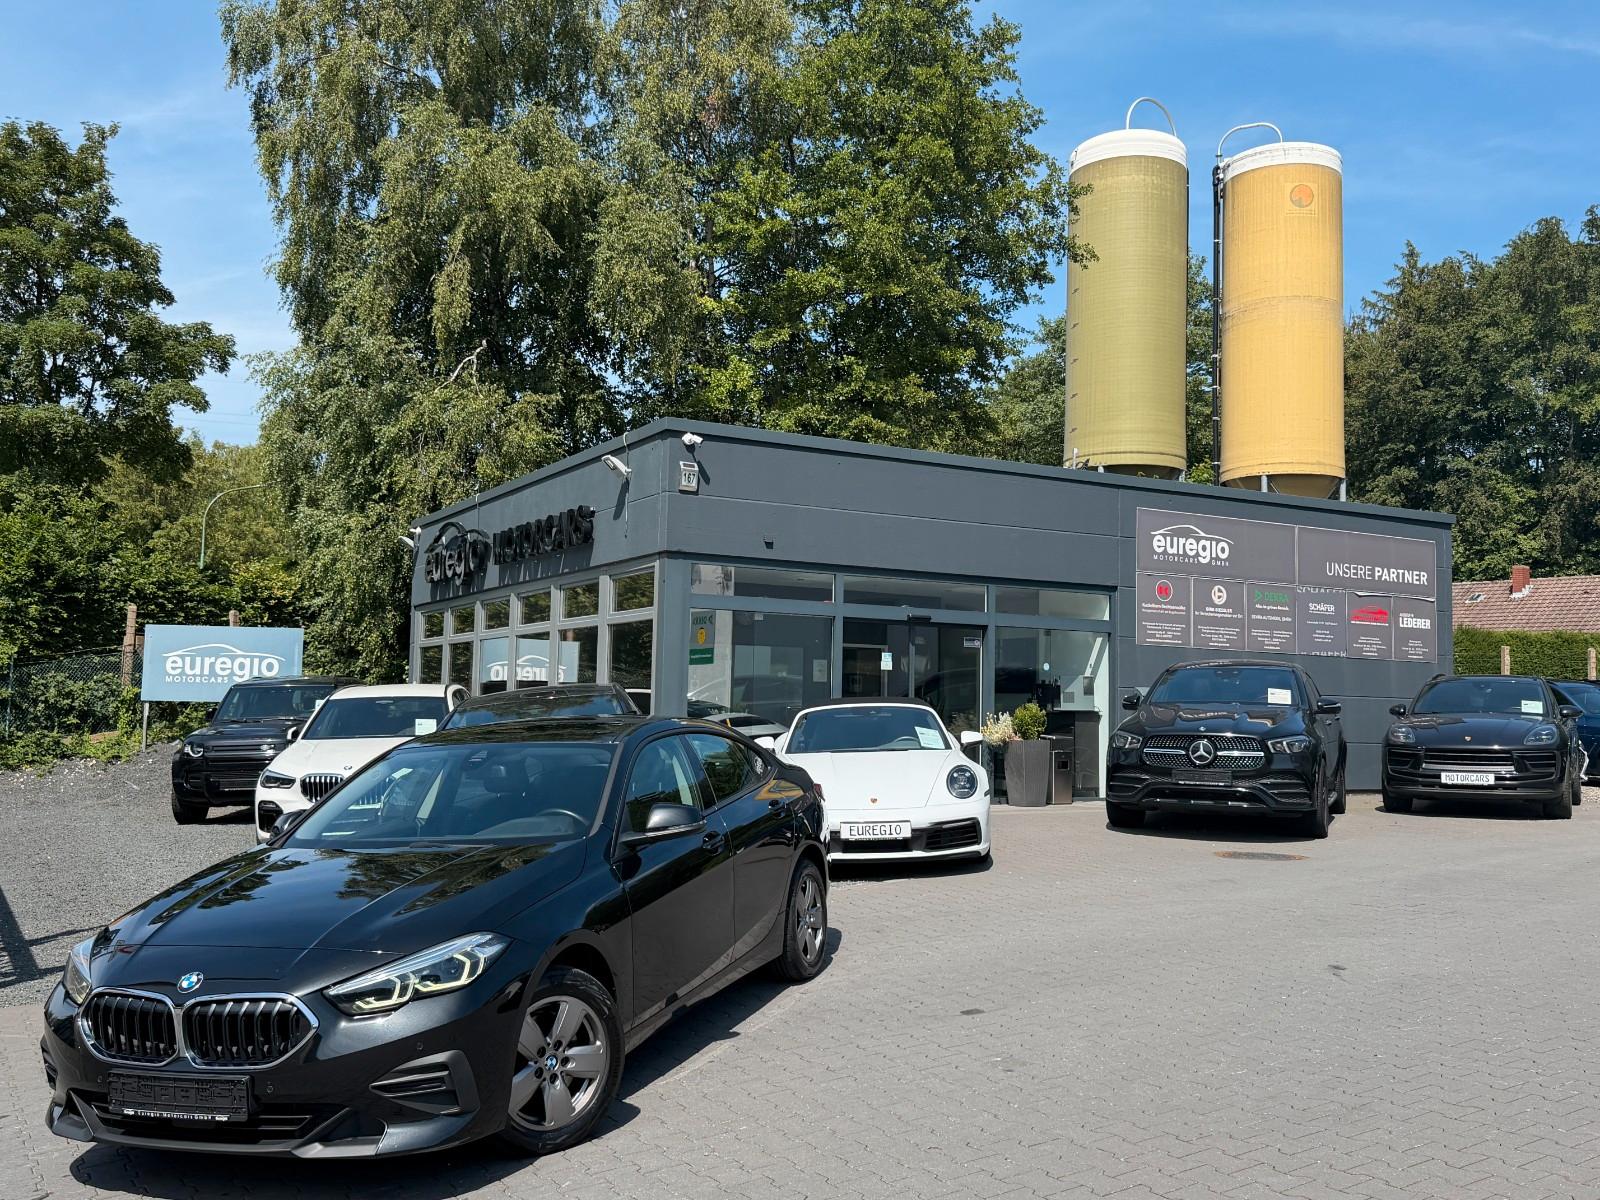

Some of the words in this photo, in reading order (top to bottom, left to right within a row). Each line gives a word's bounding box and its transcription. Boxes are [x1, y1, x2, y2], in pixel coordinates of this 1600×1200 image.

[683, 472, 696, 483] 167
[1153, 535, 1230, 564] euregio
[1153, 555, 1198, 564] MOTORCARS
[1326, 561, 1373, 580] UNSERE
[1374, 567, 1428, 586] PARTNER
[1308, 602, 1335, 612] SCHÄFER
[1399, 617, 1431, 629] LEDERER
[165, 656, 280, 682] euregio
[1445, 774, 1490, 783] MOTORCARS
[849, 824, 902, 837] EUREGIO
